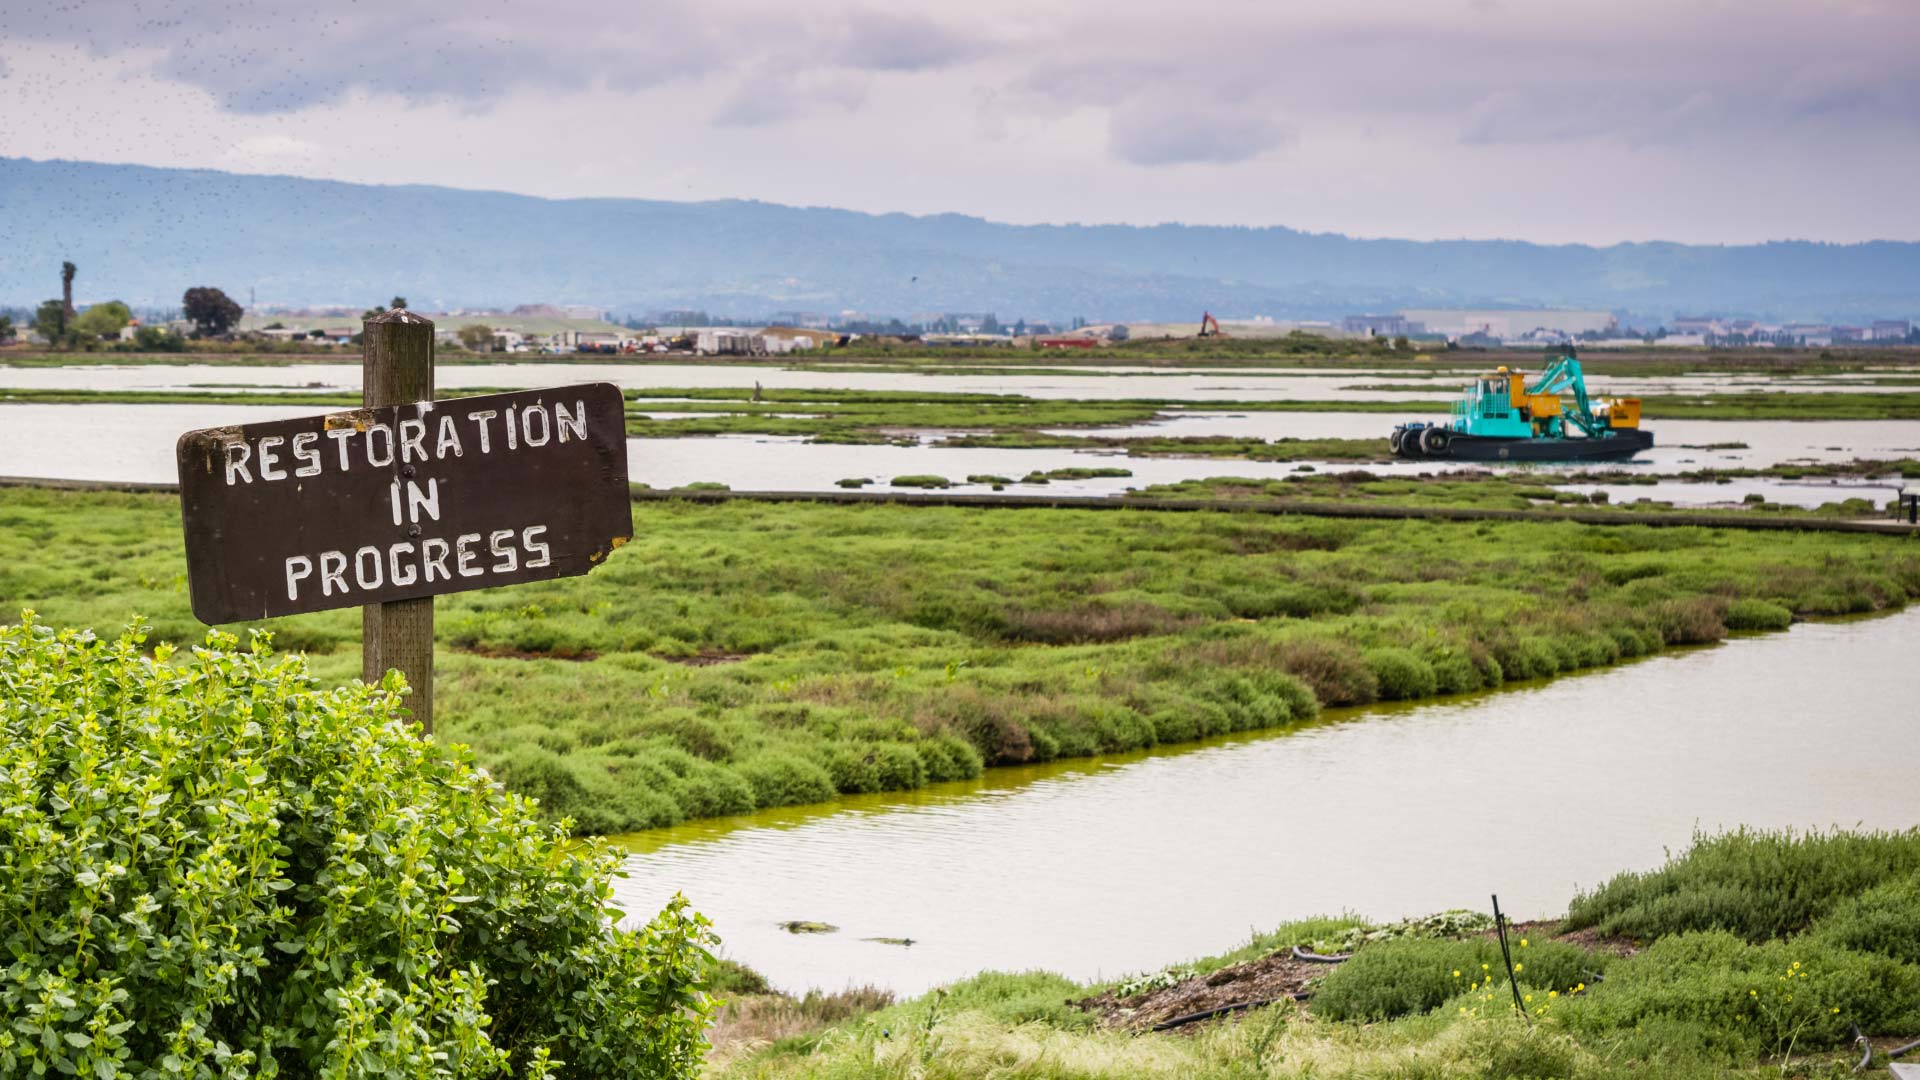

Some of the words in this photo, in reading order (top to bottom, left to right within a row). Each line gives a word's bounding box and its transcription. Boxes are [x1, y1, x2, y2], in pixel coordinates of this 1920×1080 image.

[225, 400, 587, 486] RESTORATION
[390, 477, 440, 526] IN
[285, 525, 551, 601] PROGRESS
